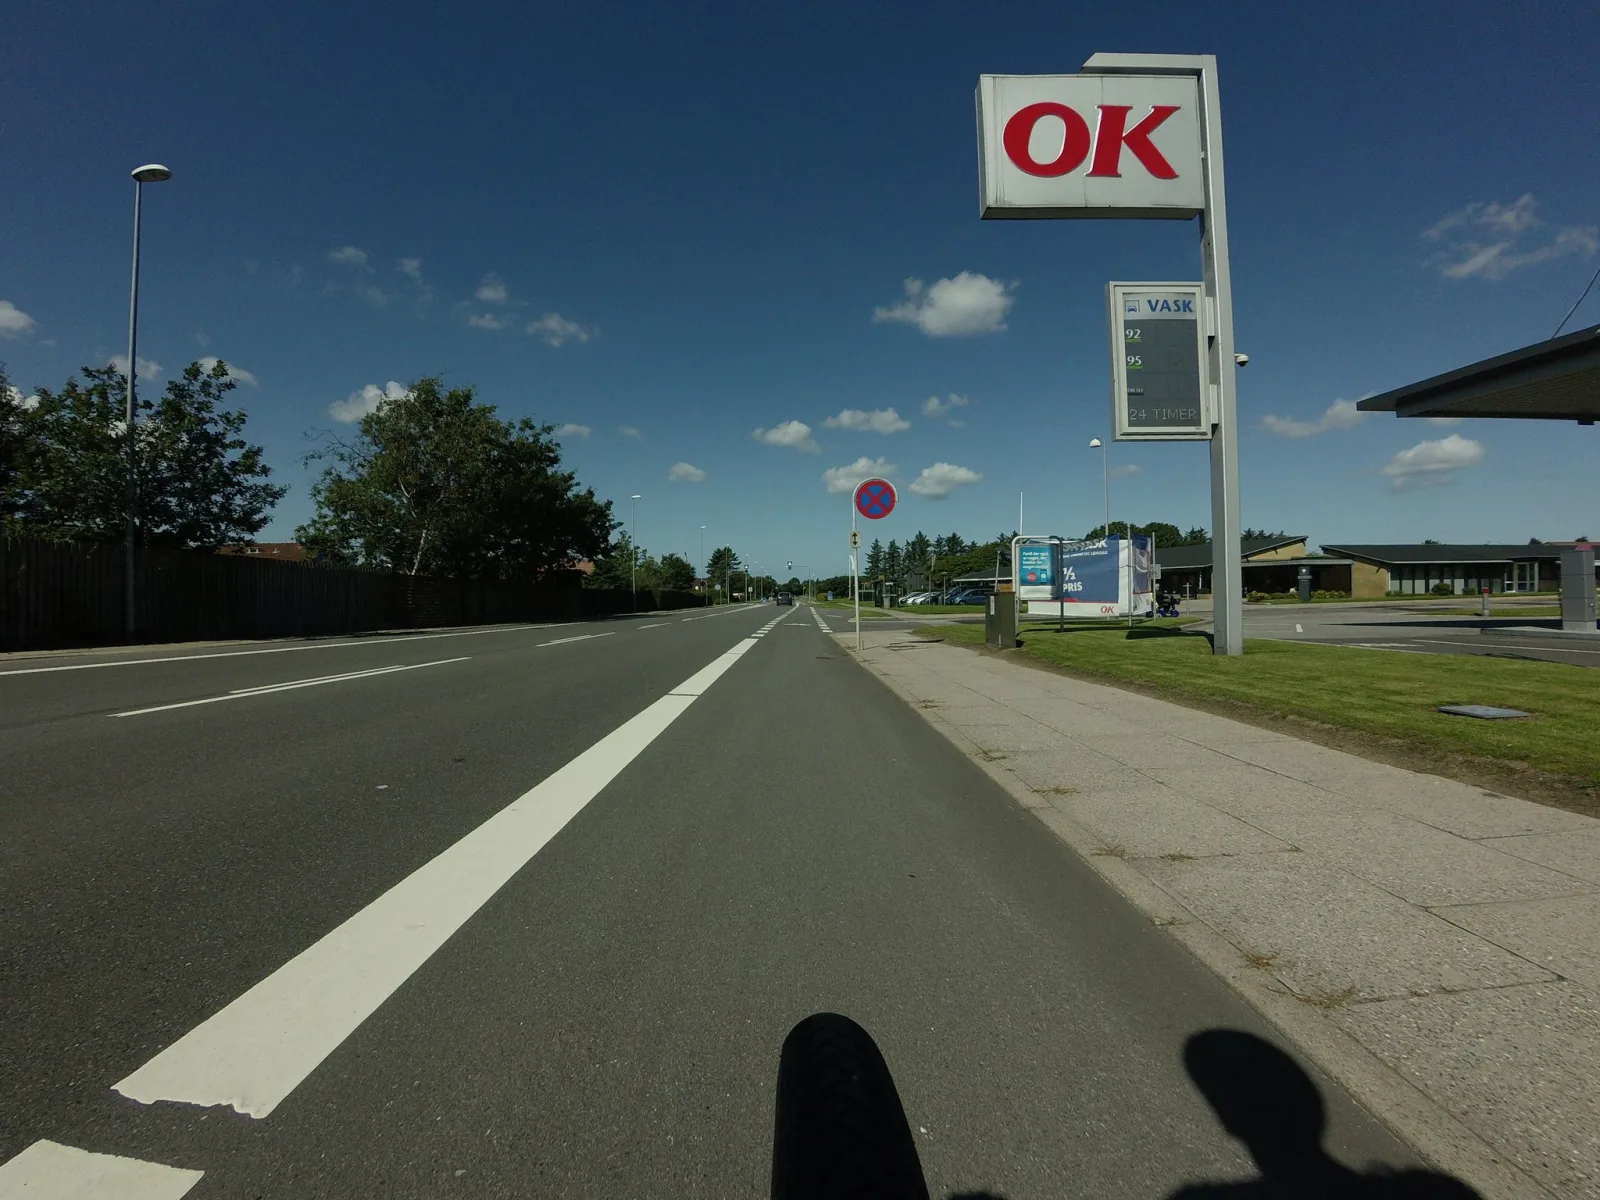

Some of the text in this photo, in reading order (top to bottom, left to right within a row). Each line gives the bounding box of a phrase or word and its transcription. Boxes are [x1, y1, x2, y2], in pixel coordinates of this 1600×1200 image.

[1003, 102, 1181, 179] OK
[1147, 299, 1193, 312] VASK
[1126, 328, 1141, 339] 92
[1127, 355, 1142, 366] 95
[1129, 408, 1197, 420] 24 TIMER
[1063, 581, 1083, 592] PRIS
[1100, 605, 1115, 614] OK
